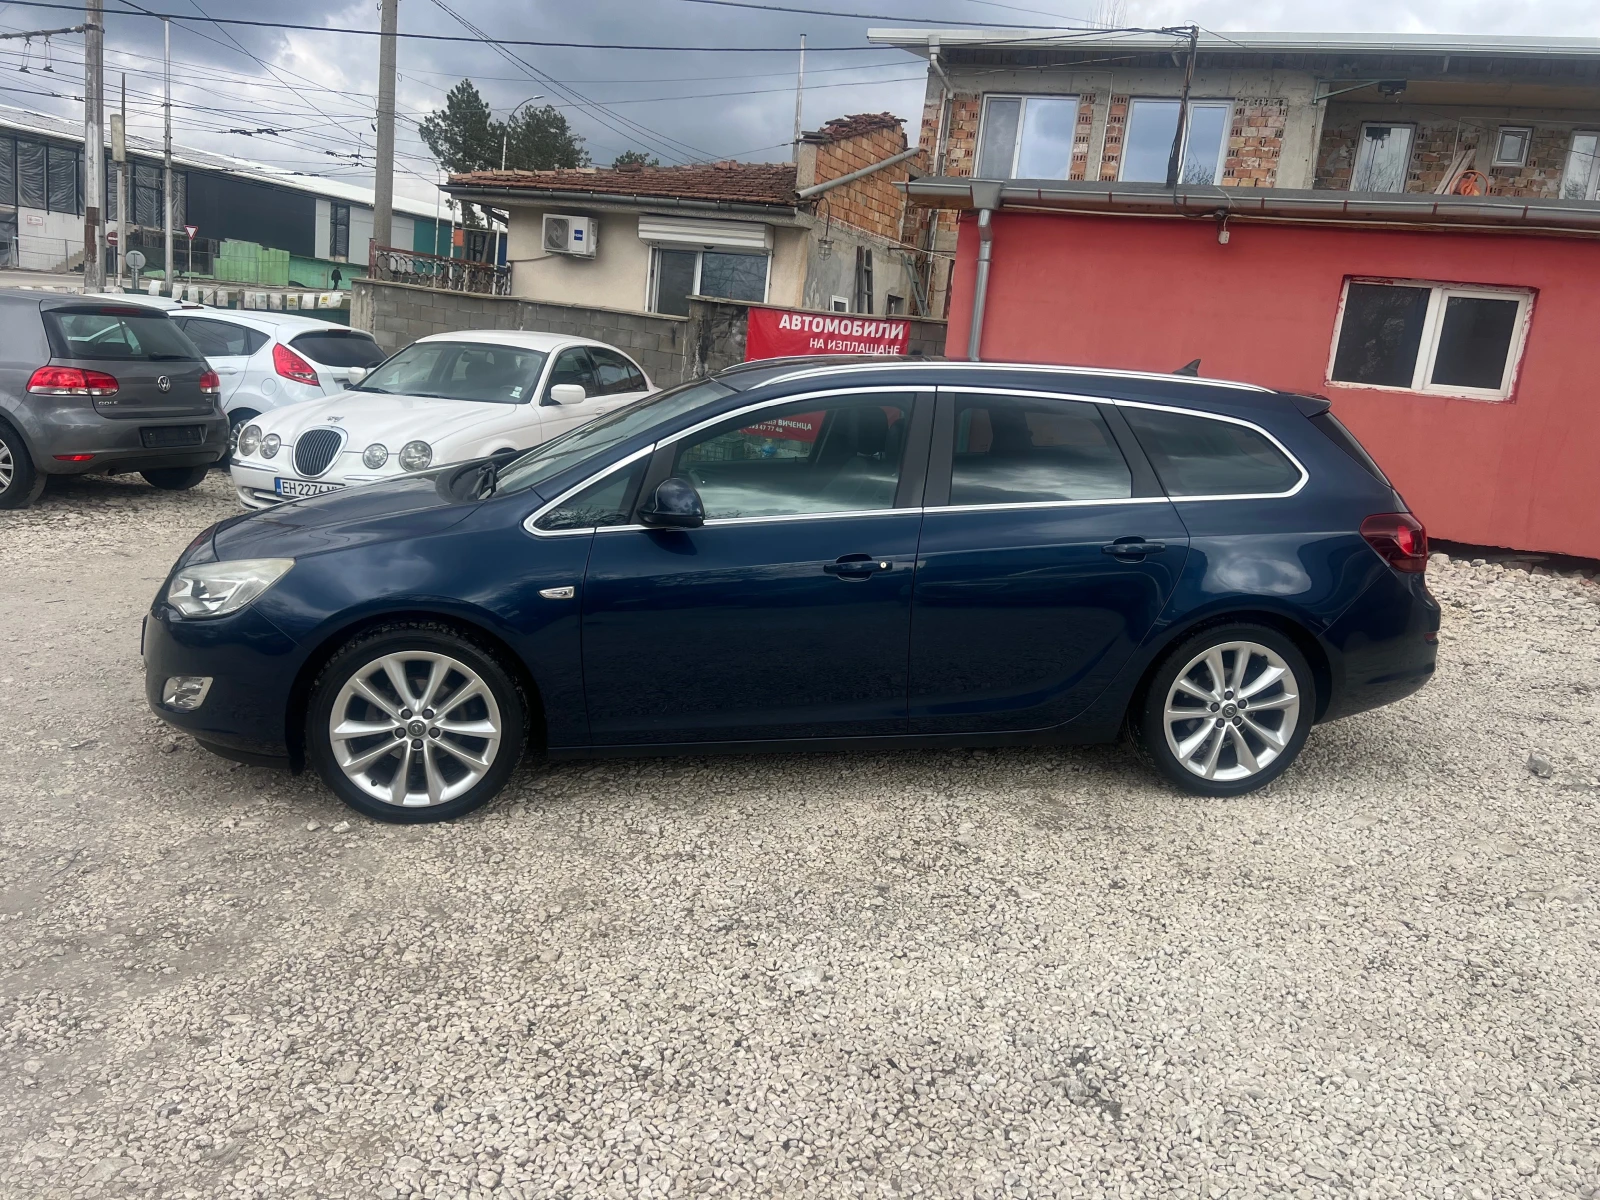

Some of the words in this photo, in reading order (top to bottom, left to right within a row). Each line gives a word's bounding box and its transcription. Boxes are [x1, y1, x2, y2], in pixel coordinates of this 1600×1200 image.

[779, 314, 904, 340] АВТОМОБИЛИ
[809, 337, 825, 350] НА
[827, 339, 900, 355] ИЗПЛАЩАНЕ
[778, 419, 812, 431] ВИЧЕНЦА
